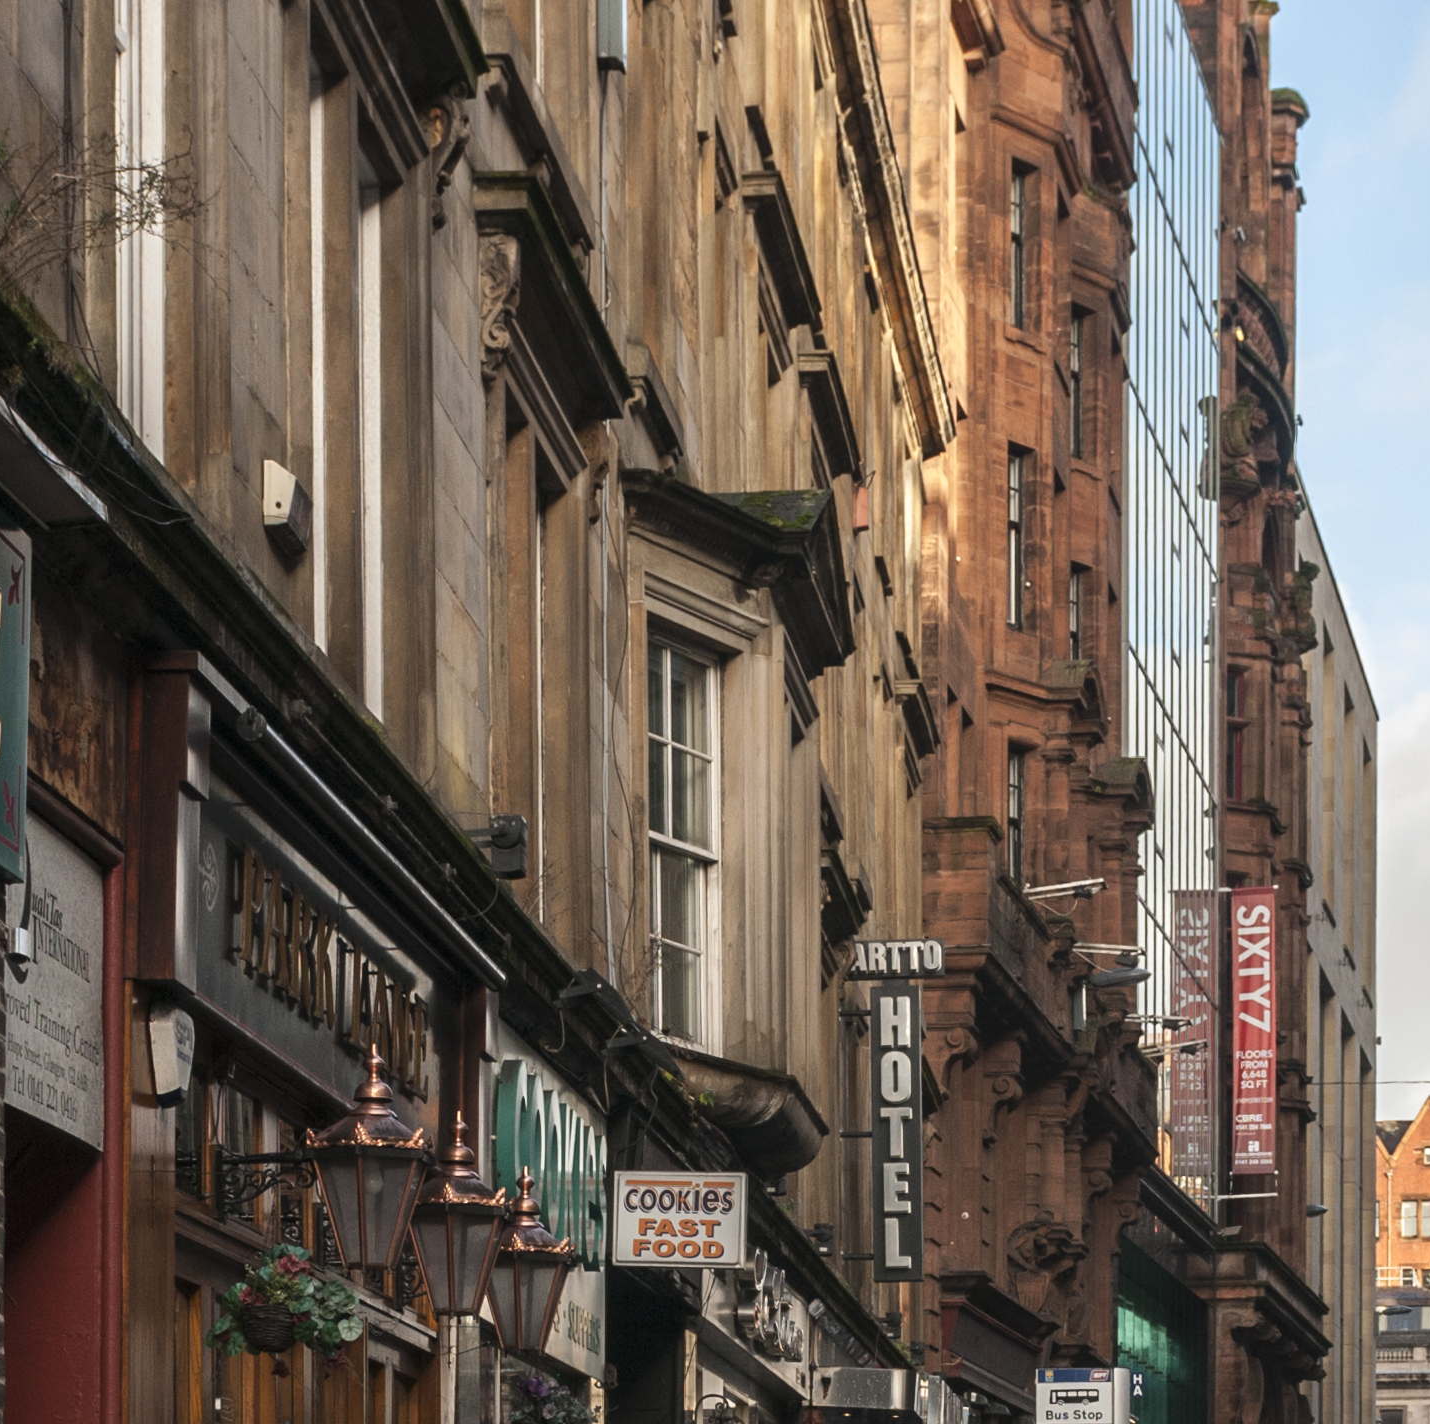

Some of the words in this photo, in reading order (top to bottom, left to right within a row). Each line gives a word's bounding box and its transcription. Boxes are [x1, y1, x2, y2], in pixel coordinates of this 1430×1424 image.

[31, 913, 90, 983] INTERNATIONAL
[851, 940, 942, 973] ARTTO
[238, 843, 334, 1031] PARK
[348, 938, 428, 1104] LANE
[1236, 905, 1271, 1033] SIXTY7
[34, 1000, 72, 1057] Training
[1235, 1050, 1273, 1059] FLOORS
[1241, 1060, 1268, 1070] FROM
[12, 1065, 25, 1096] Tel
[28, 1074, 43, 1105] 0141
[1241, 1080, 1254, 1089] SQ
[1257, 1080, 1268, 1089] FT
[879, 996, 913, 1269] HOTEL
[1235, 1114, 1263, 1123] CBRE
[638, 1219, 721, 1238] FAST
[633, 1239, 724, 1258] FOOD
[568, 1301, 601, 1355] SUPPERS
[1046, 1410, 1069, 1420] Bus
[1073, 1410, 1103, 1421] Stop
